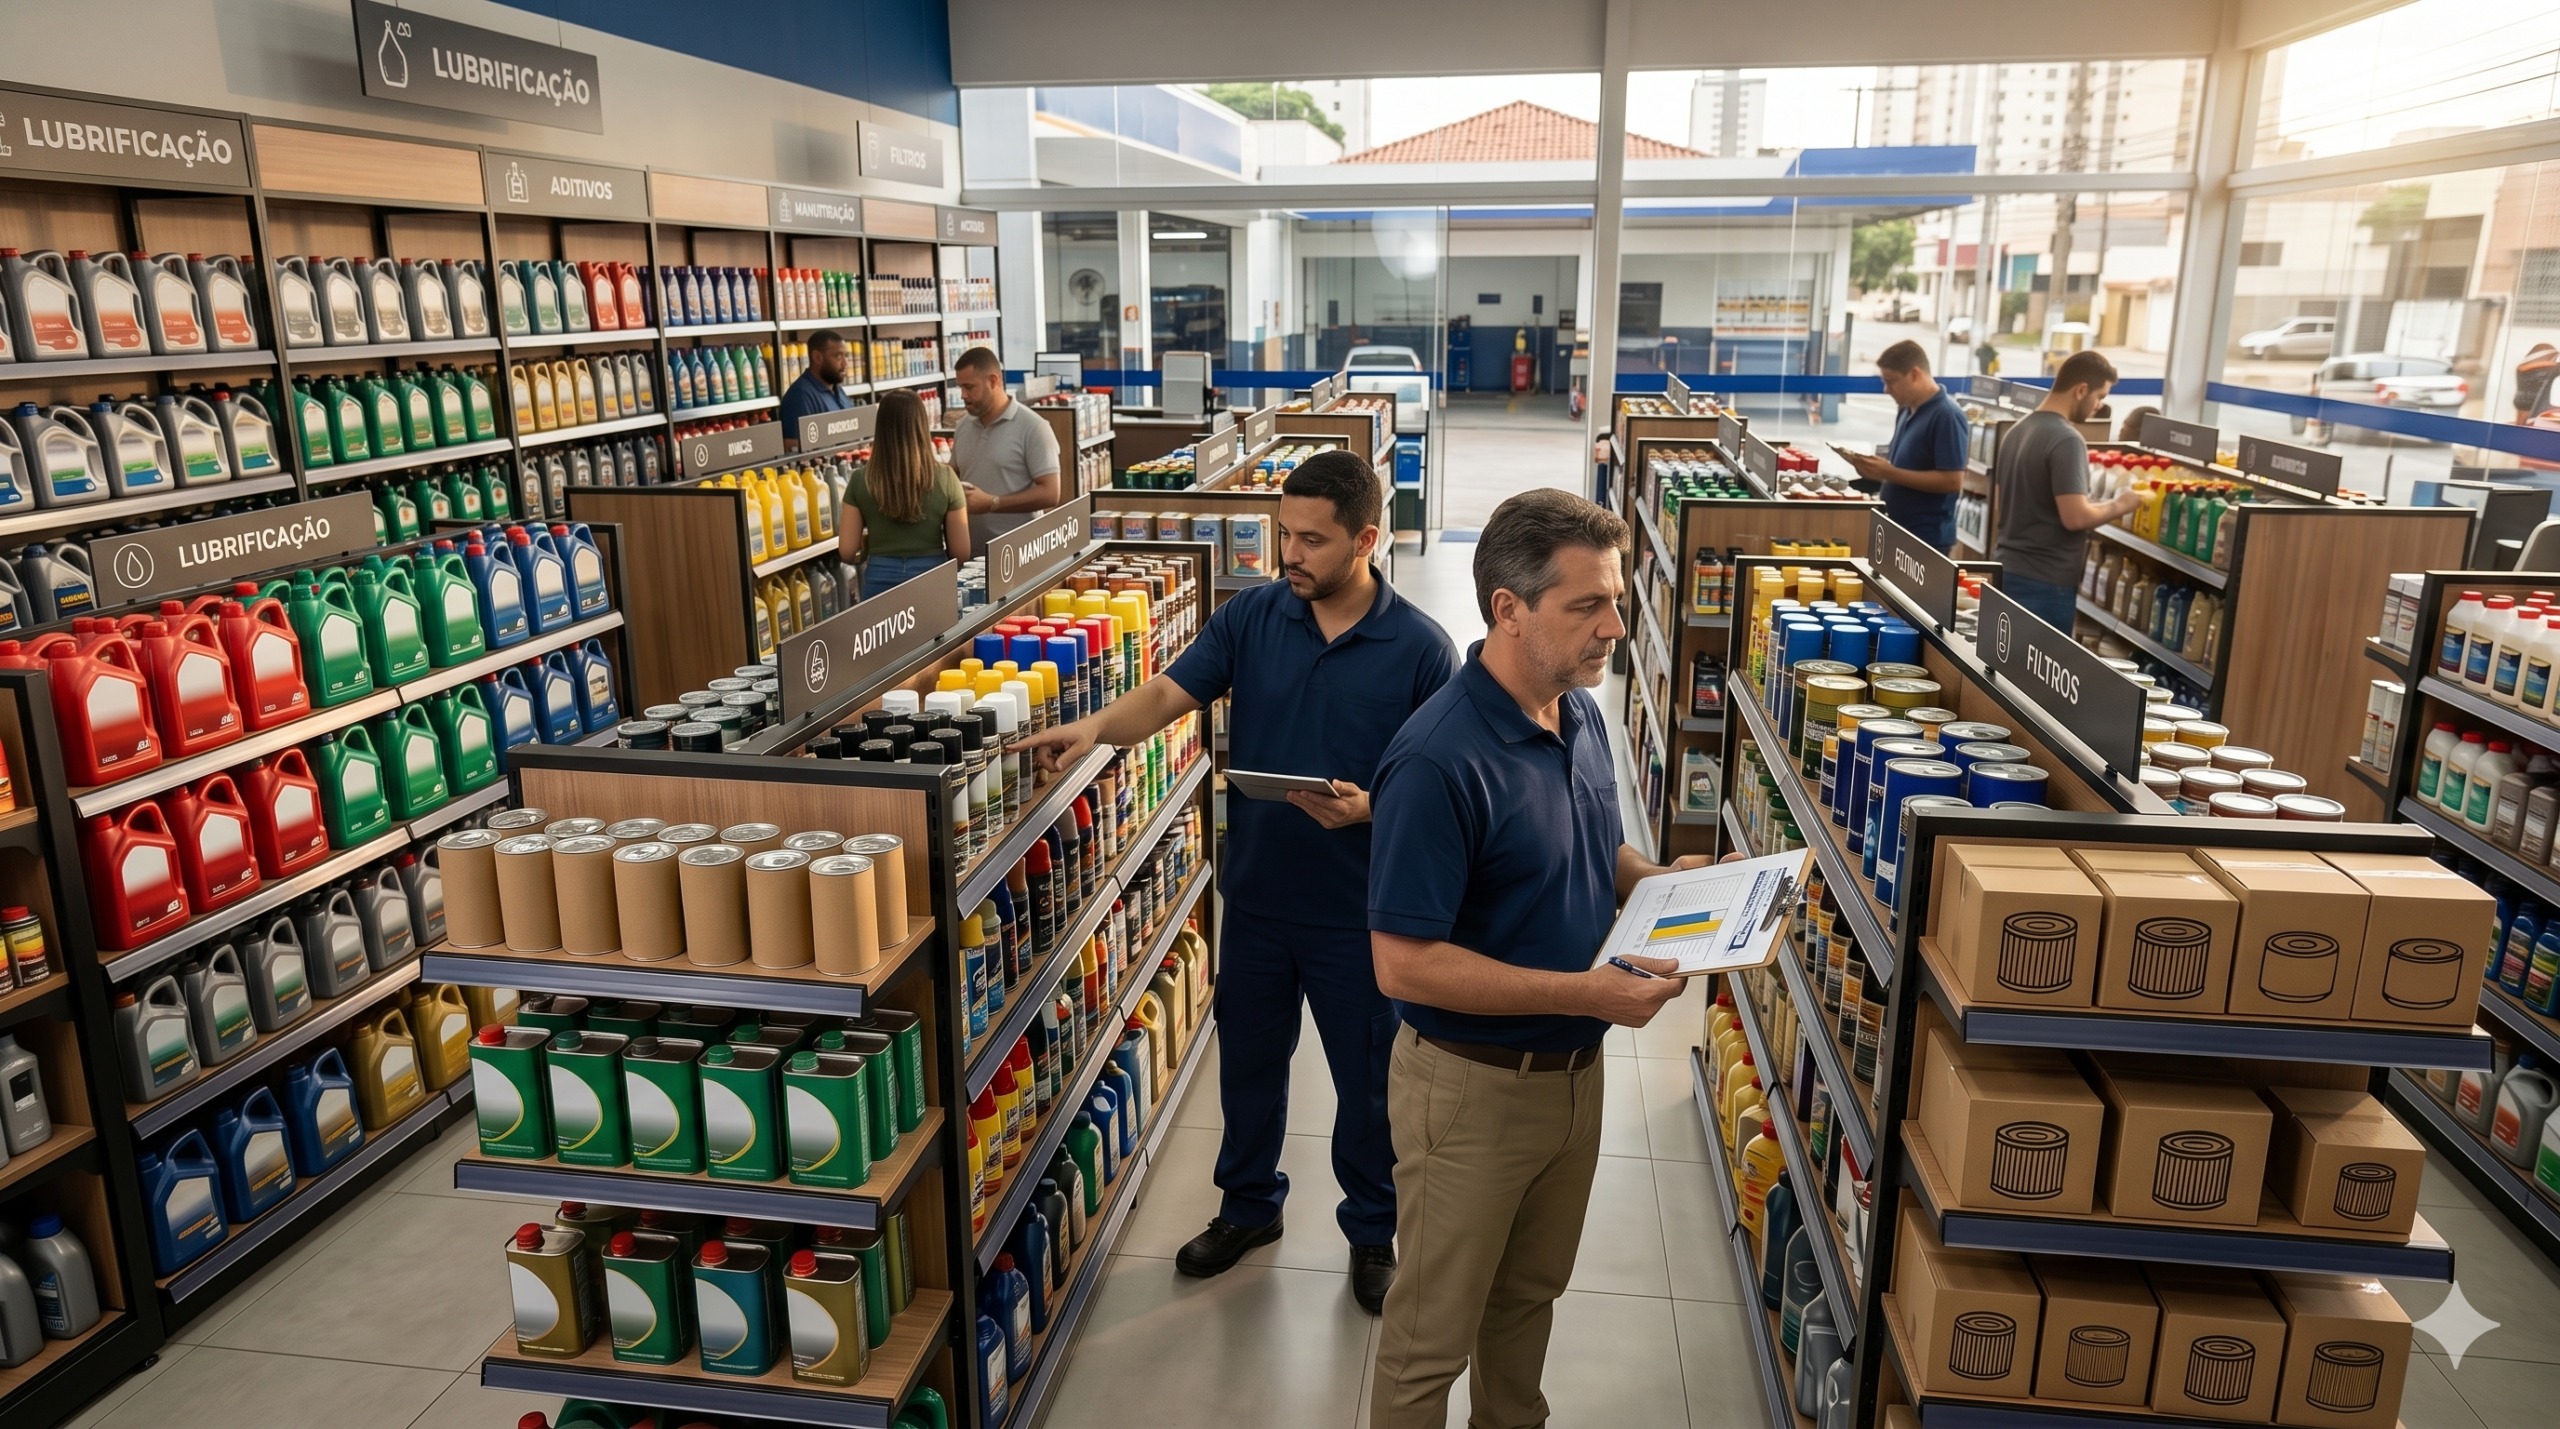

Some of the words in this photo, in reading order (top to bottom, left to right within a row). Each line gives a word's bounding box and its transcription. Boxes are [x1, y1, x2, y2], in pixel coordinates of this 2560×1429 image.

[432, 46, 590, 107] LUBRIFICAÇÃO
[22, 117, 233, 168] LUBRIFICAÇÃO
[890, 146, 927, 170] FILTROS
[550, 176, 613, 200] ADITIVOS
[178, 515, 331, 569] LUBRIFICAÇÃO
[852, 605, 916, 661] ADITIVOS
[2026, 643, 2080, 705] FILTROS
